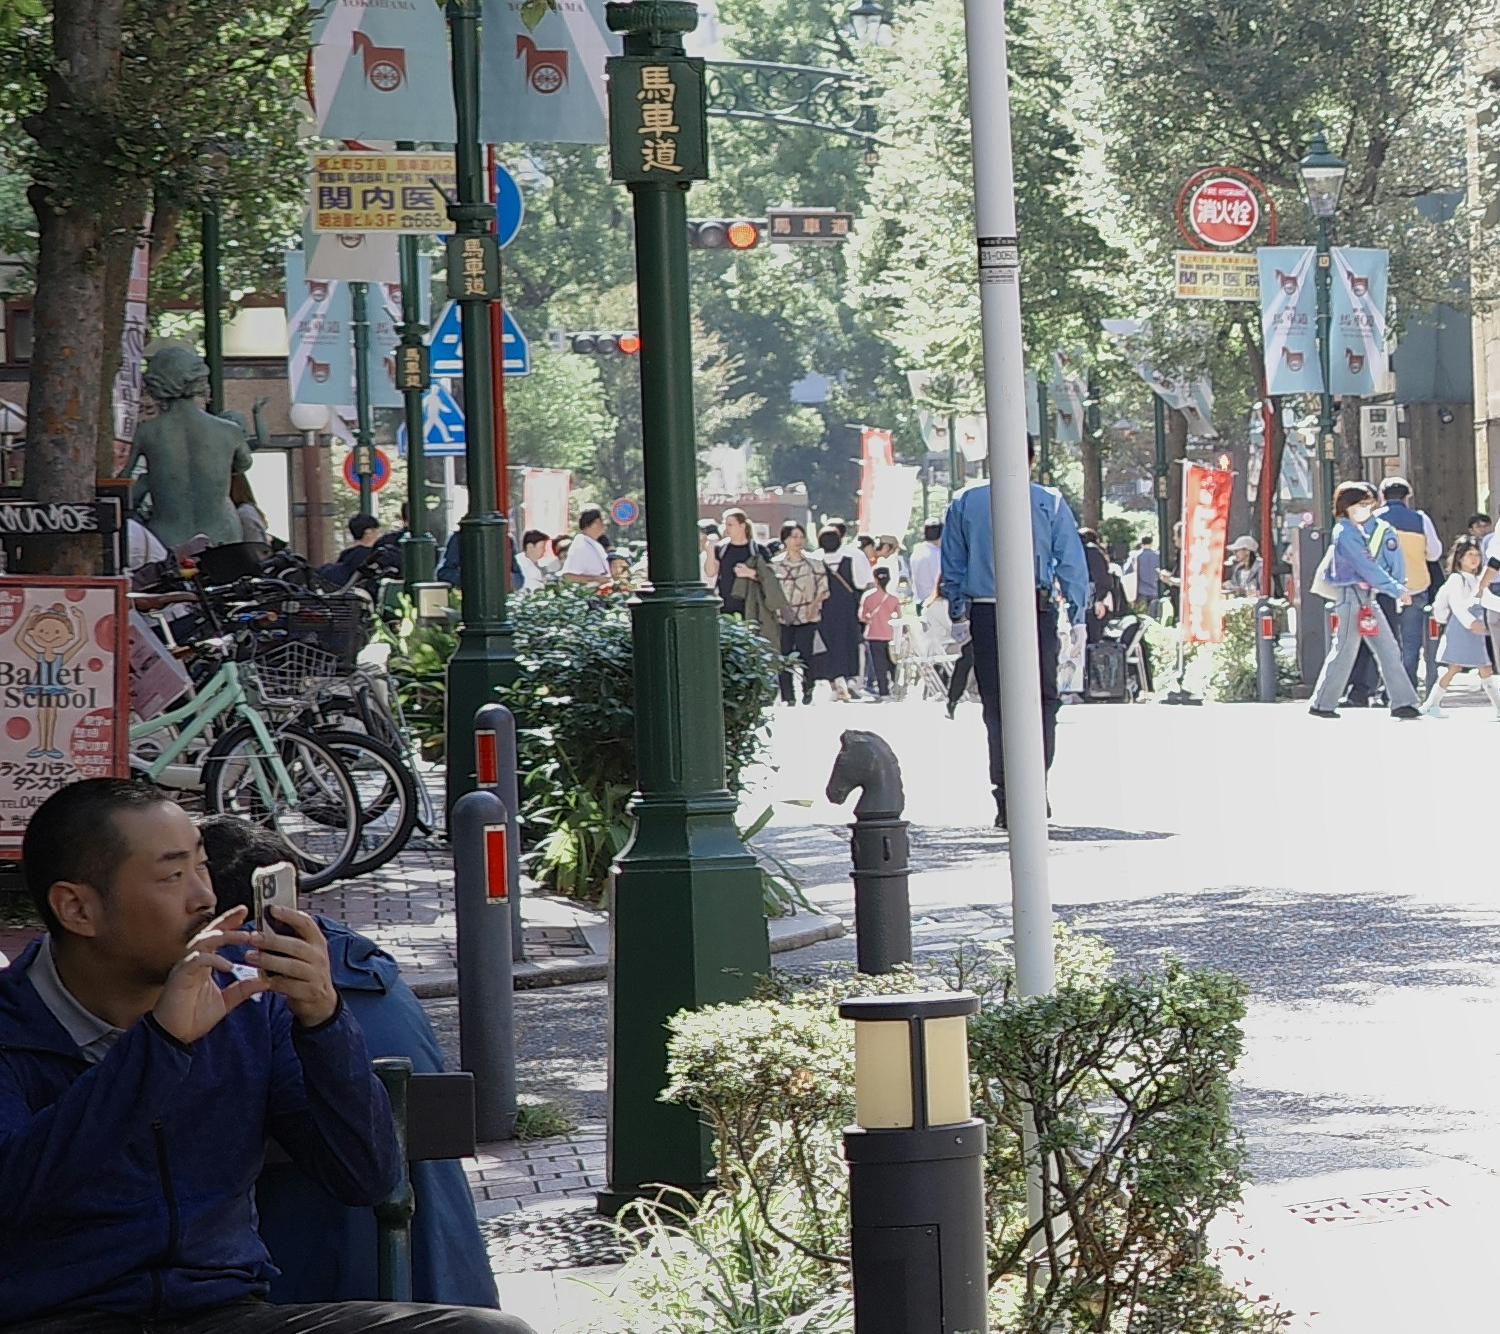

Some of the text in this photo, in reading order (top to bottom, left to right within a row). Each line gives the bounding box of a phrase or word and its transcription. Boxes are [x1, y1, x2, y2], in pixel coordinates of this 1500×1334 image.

[635, 65, 685, 173] 馬車道
[1197, 199, 1252, 226] 消火栓
[461, 238, 488, 296] 馬車道
[0, 662, 85, 686] Ballet
[4, 686, 98, 709] School
